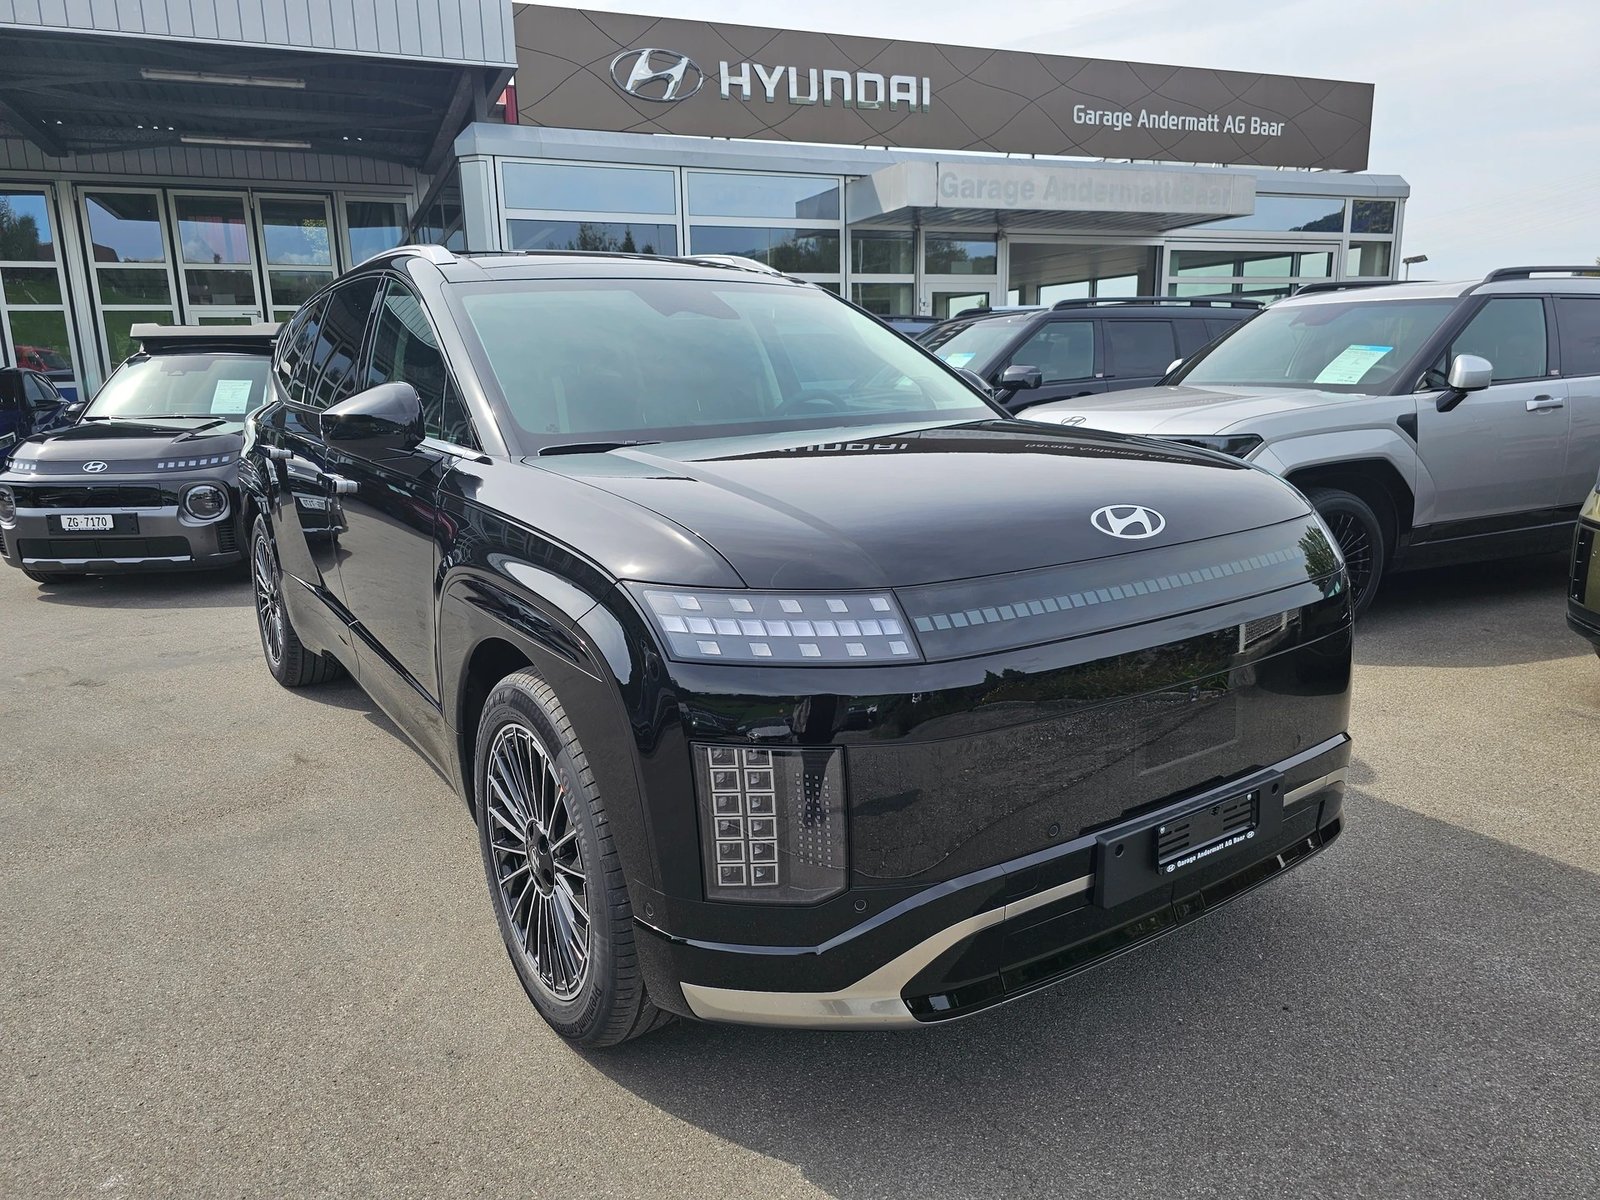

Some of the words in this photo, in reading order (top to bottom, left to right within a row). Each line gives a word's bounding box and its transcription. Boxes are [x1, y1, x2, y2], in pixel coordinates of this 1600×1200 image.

[719, 61, 931, 113] HYUNDAI
[1073, 104, 1132, 131] Garage
[1137, 109, 1219, 133] Andermatt
[1223, 115, 1246, 134] AG
[1251, 116, 1285, 136] Baar
[939, 172, 1035, 205] Garage
[1176, 855, 1196, 868] Garage
